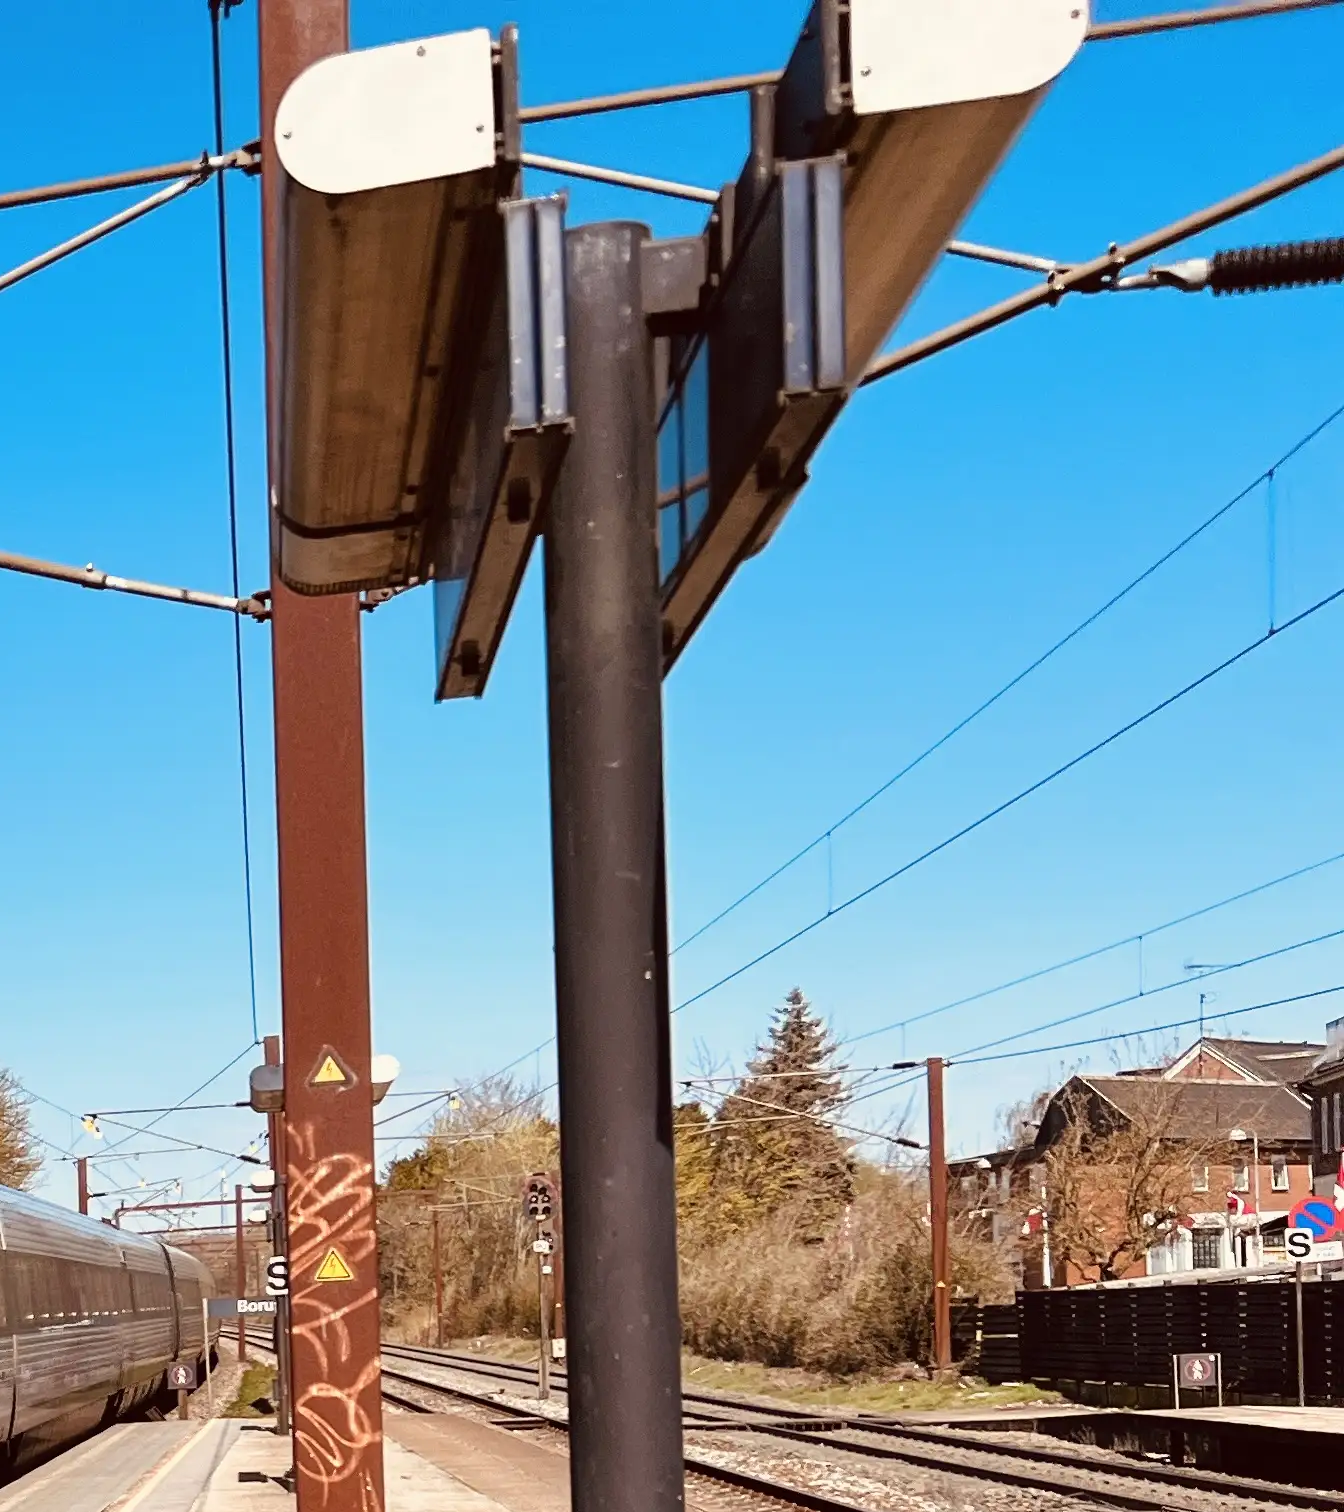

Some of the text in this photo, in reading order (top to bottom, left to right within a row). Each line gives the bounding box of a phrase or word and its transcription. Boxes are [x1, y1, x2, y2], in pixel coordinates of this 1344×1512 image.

[1288, 1232, 1311, 1258] S
[267, 1261, 289, 1290] S
[237, 1299, 277, 1314] Boru
